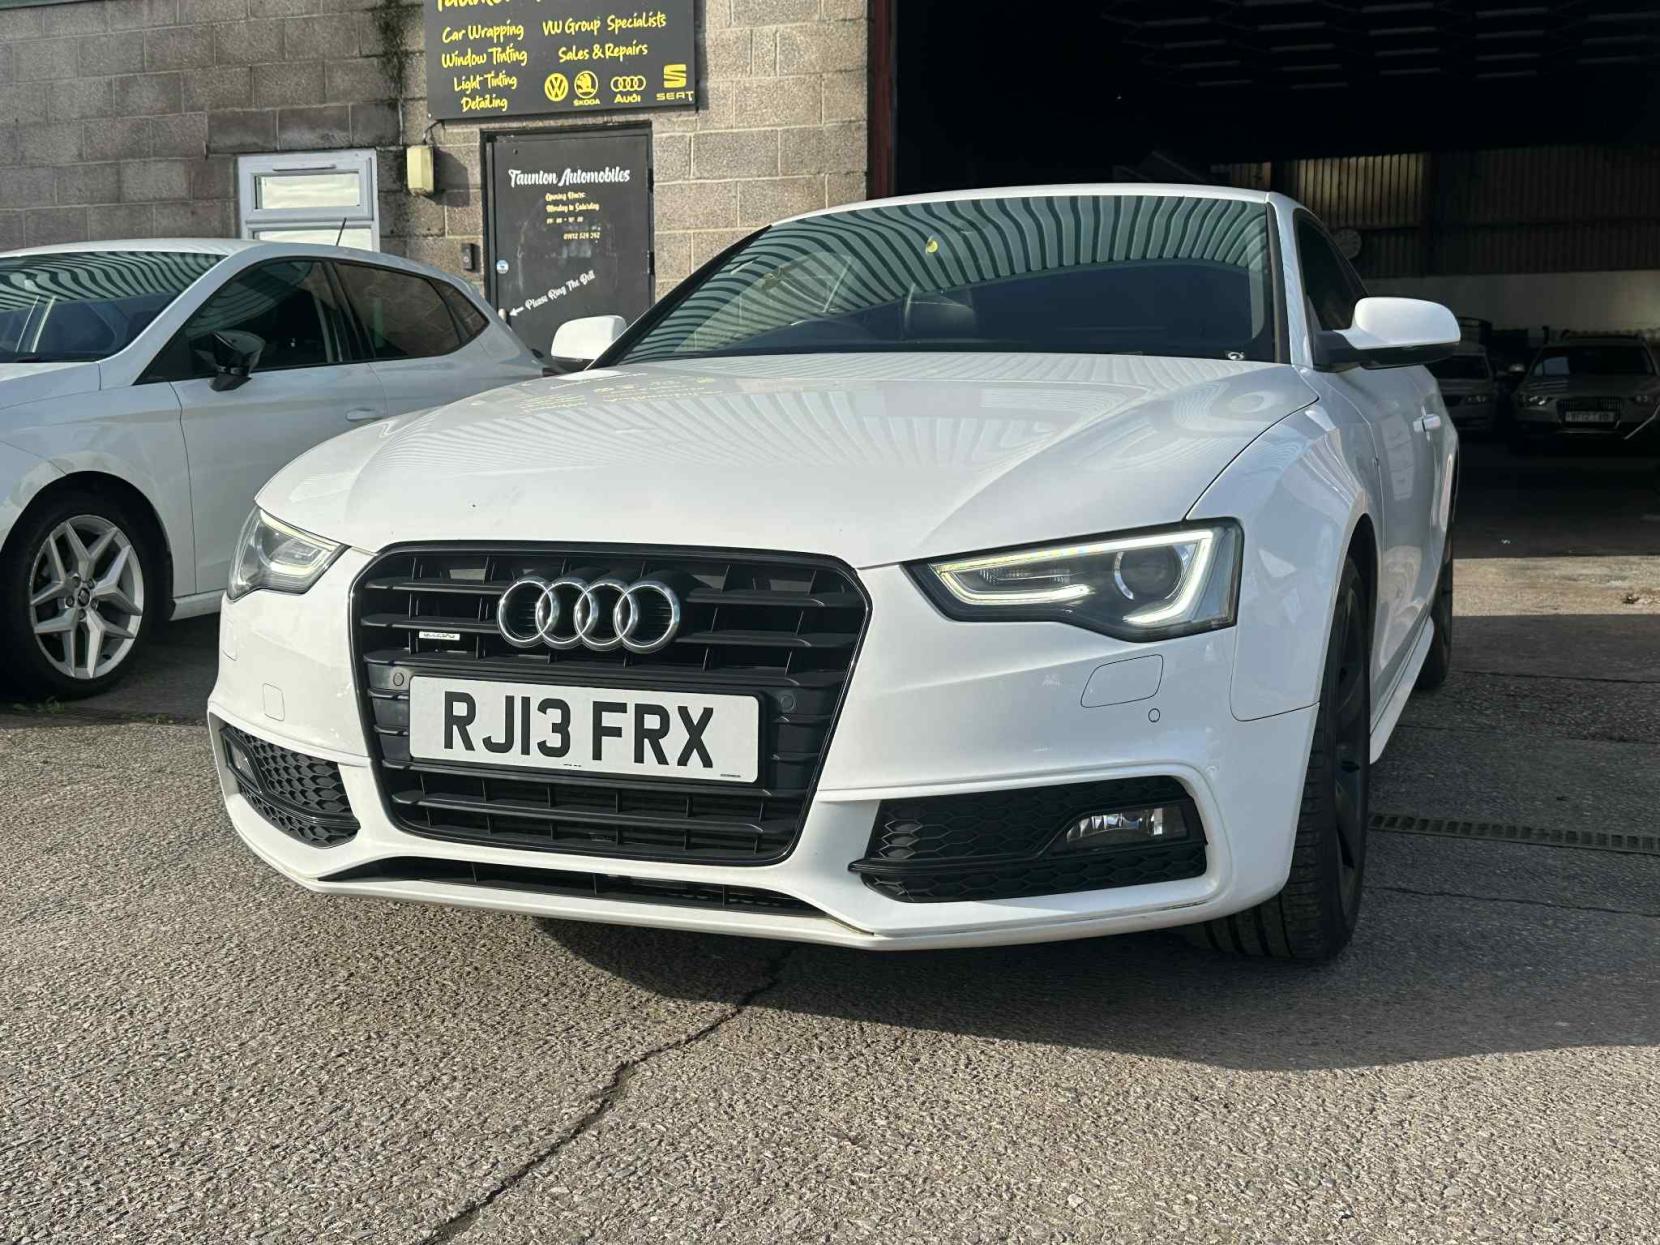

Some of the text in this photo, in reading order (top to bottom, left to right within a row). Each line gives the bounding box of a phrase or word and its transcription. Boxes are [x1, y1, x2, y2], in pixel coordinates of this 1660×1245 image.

[442, 19, 524, 43] Car Wrapping
[542, 11, 667, 36] VW Group Specialists
[441, 43, 528, 68] Window Tinting
[558, 40, 649, 63] Sales & Repairs
[453, 70, 518, 94] Light Tinting
[461, 94, 508, 112] Detailing
[656, 91, 694, 102] SEAT
[508, 166, 631, 188] Taunton Automobiles
[524, 269, 596, 310] Please Ring The Bell
[443, 690, 714, 769] RJ13 FRX
